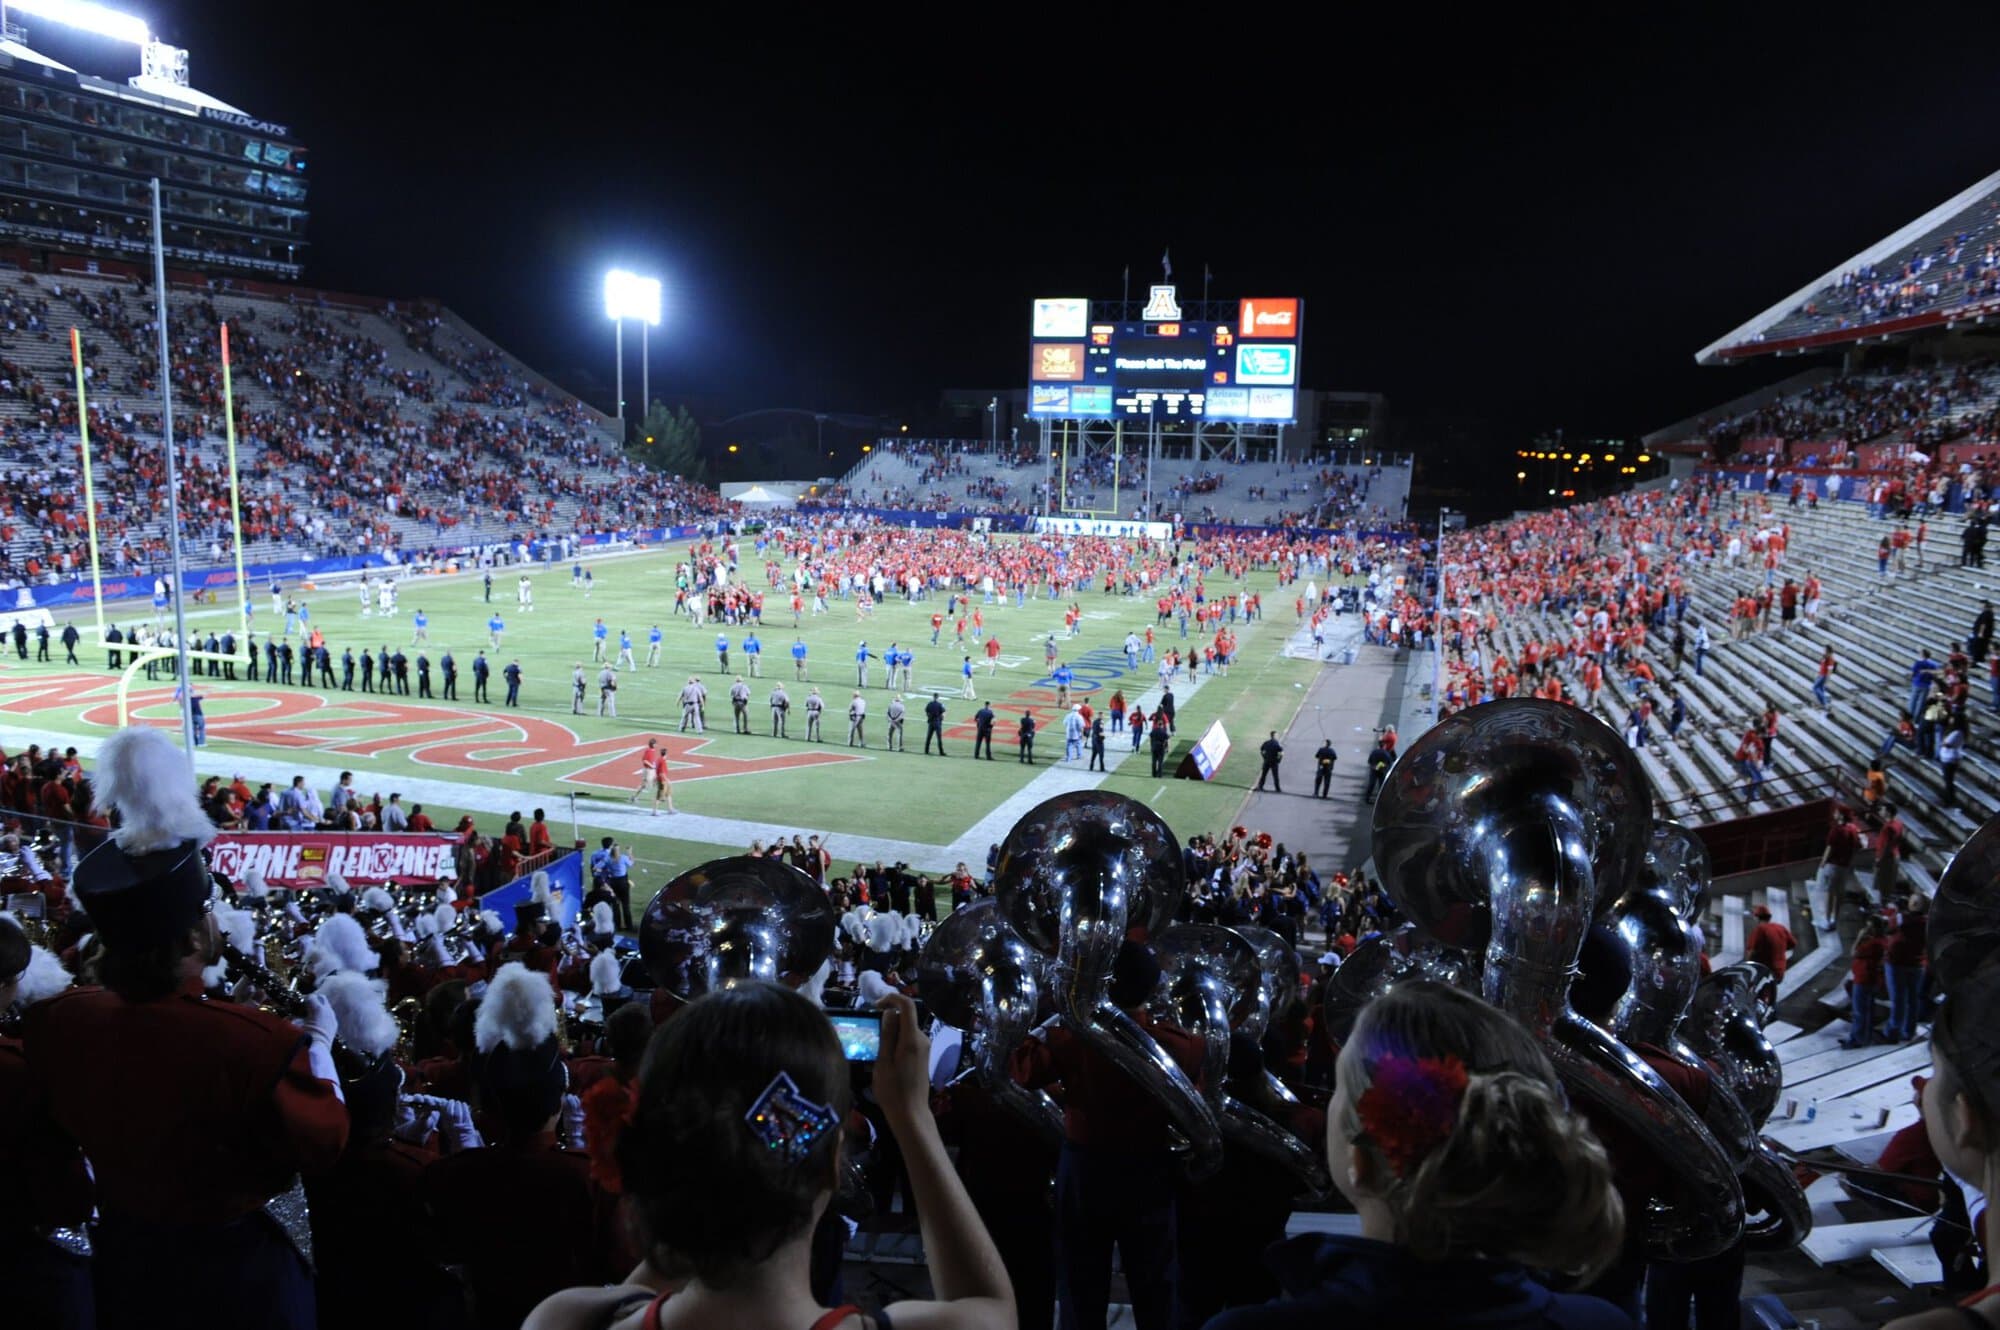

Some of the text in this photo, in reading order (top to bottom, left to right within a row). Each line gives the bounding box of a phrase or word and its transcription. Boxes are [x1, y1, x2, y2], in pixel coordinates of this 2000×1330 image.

[204, 107, 287, 136] WILDCATS
[1116, 358, 1206, 369] Please Exit The Field
[1033, 385, 1068, 396] Budget
[241, 844, 299, 880] ZONE
[328, 845, 372, 877] RED
[392, 844, 438, 877] ZONE
